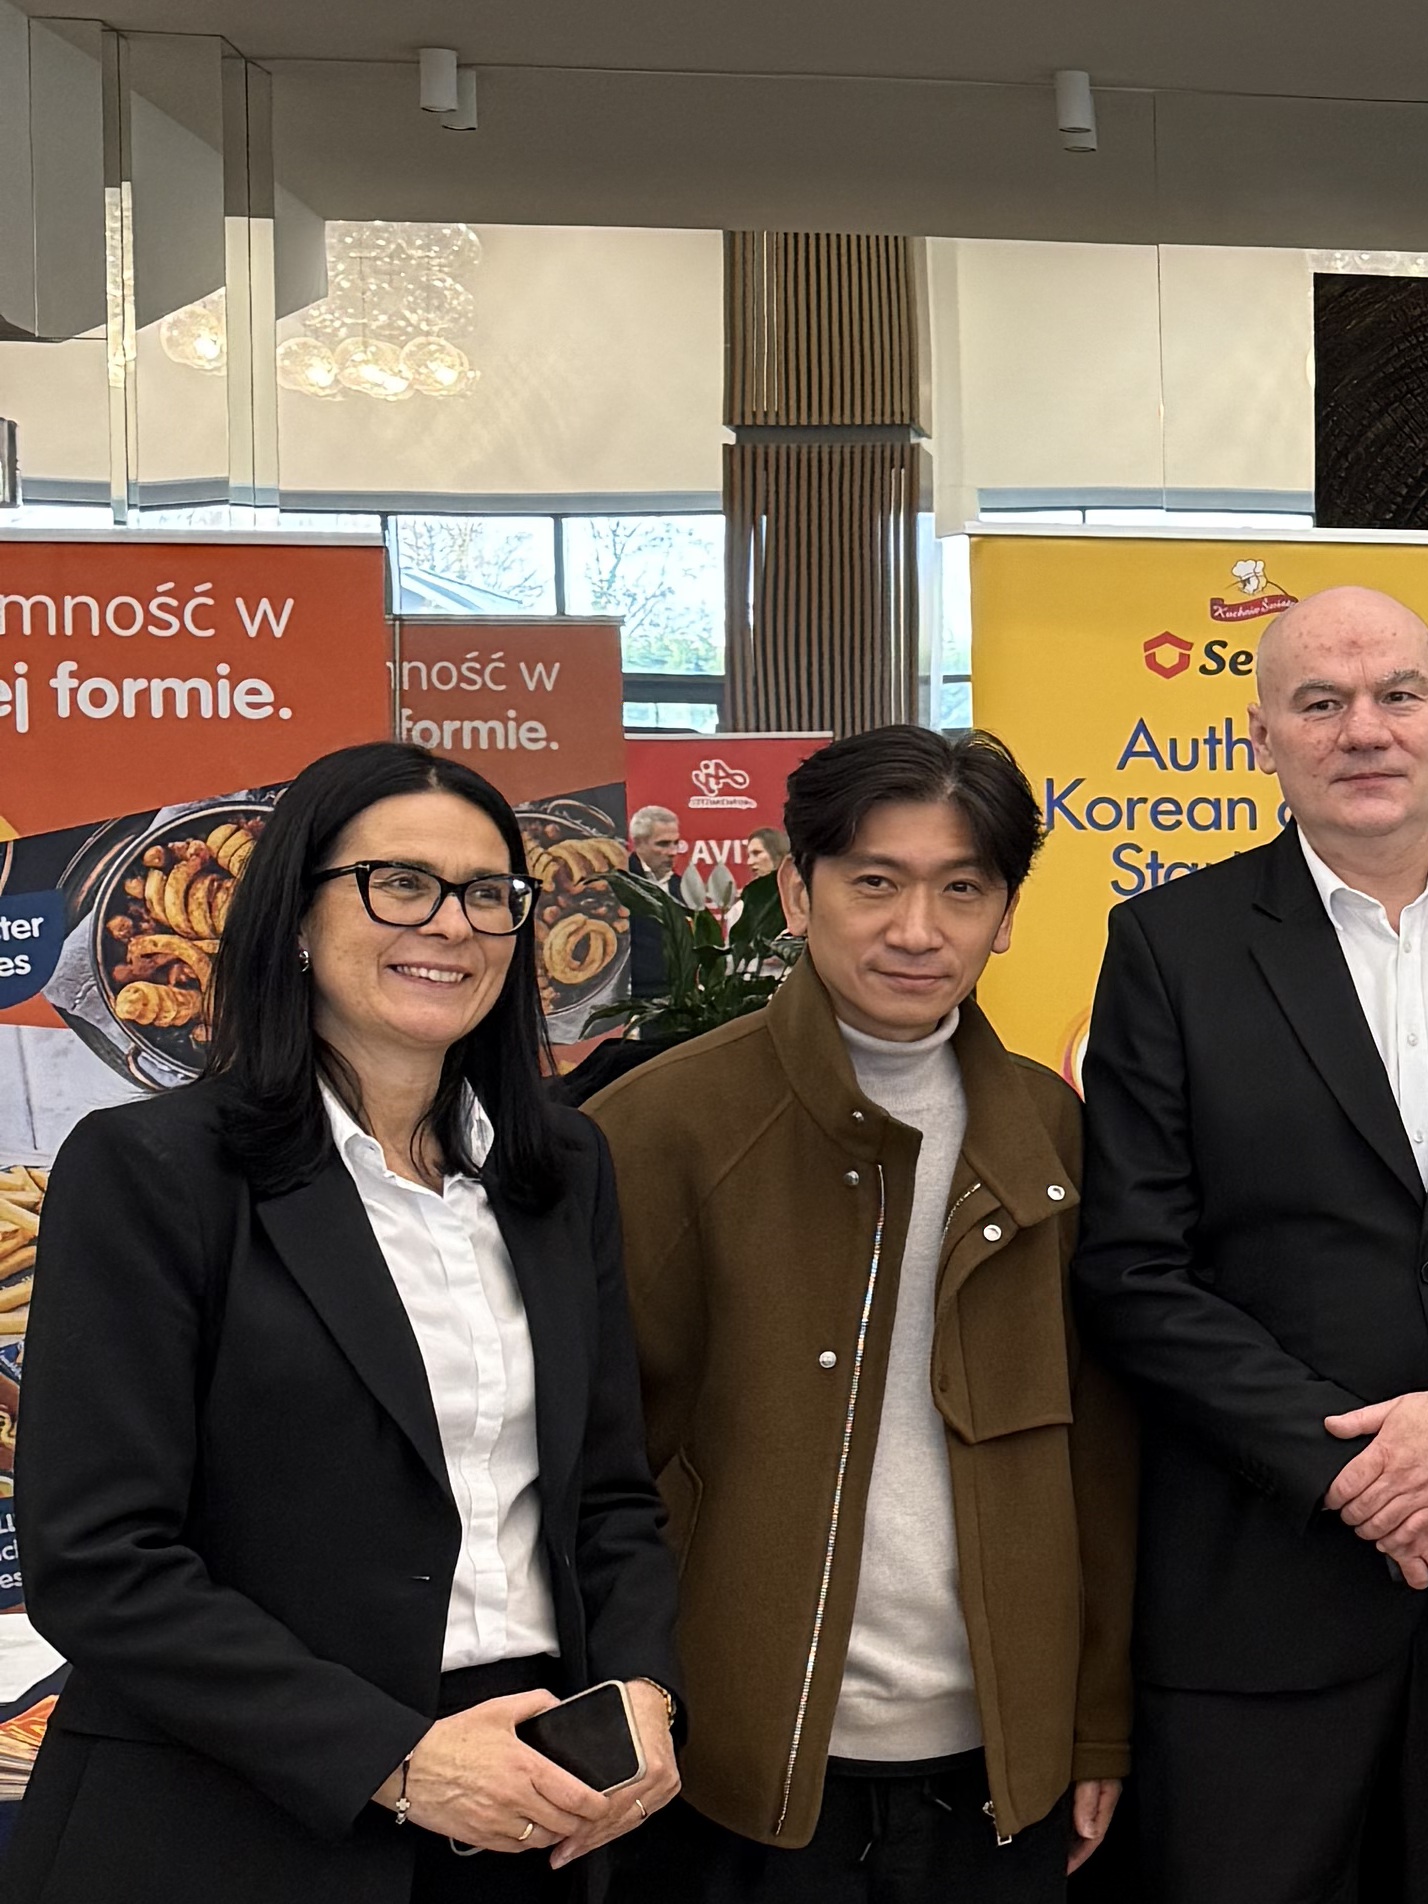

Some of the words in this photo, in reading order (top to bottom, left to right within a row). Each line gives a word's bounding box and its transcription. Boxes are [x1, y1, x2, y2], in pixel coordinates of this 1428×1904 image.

[0, 581, 216, 637] mność
[235, 596, 294, 638] w
[519, 661, 561, 692] w
[1198, 639, 1254, 676] Se
[48, 660, 293, 720] formie.
[401, 707, 560, 751] formie.
[1116, 716, 1256, 772] Auth
[1046, 777, 1258, 832] Korean
